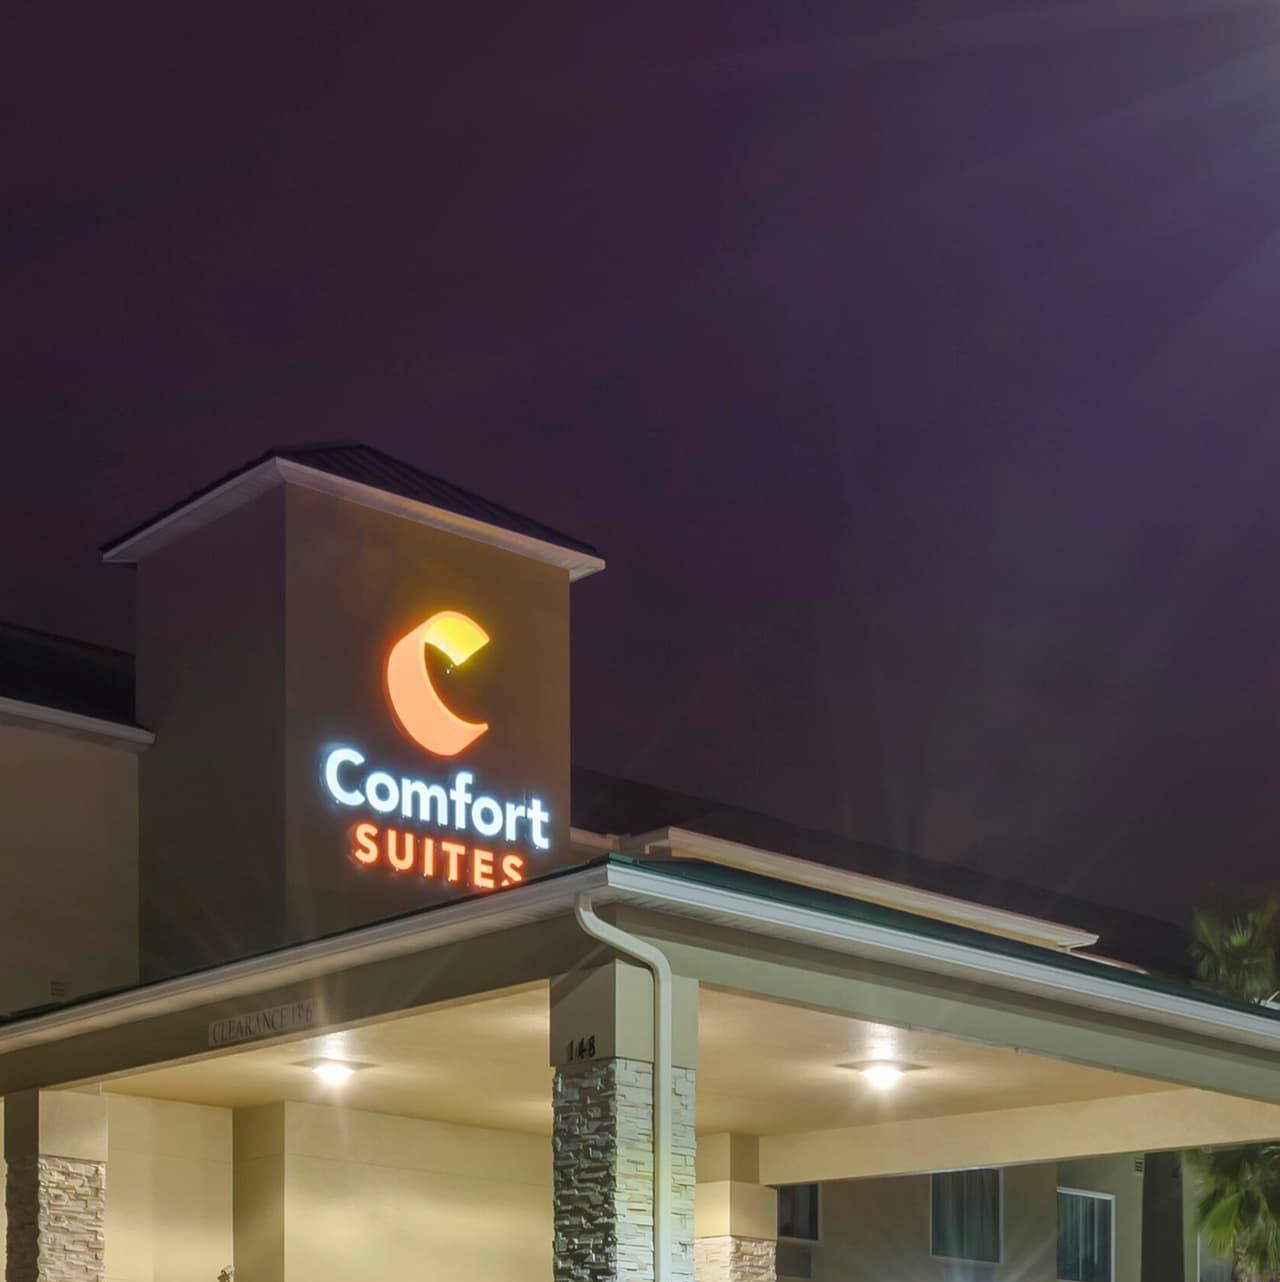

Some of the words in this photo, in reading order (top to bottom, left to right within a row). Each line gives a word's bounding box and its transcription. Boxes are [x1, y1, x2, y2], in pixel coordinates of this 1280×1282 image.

[325, 748, 549, 849] Comfort
[355, 823, 524, 888] SUITES
[212, 1007, 286, 1043] CLEARANCE
[568, 1035, 596, 1060] 148
